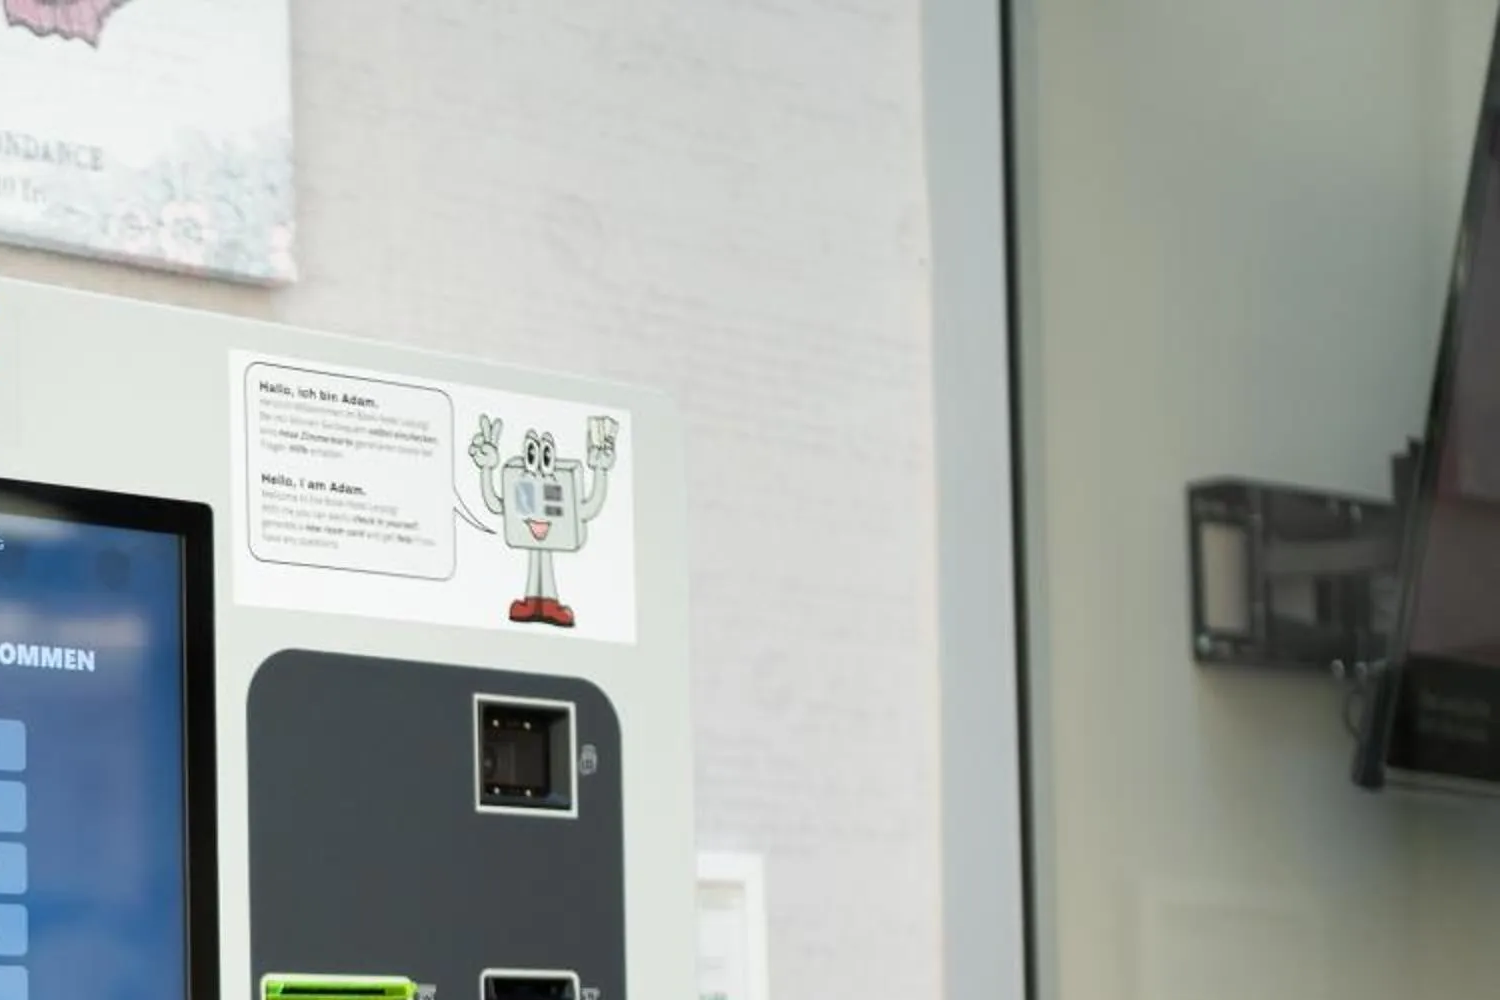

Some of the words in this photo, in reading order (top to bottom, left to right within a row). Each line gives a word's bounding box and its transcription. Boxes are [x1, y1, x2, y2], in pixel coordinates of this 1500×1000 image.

[259, 381, 294, 398] Hallo,
[298, 387, 317, 400] ich
[319, 390, 338, 403] bin
[342, 393, 379, 409] Adam.
[261, 473, 296, 488] Hello,
[307, 480, 326, 491] am
[330, 482, 366, 496] Adam.
